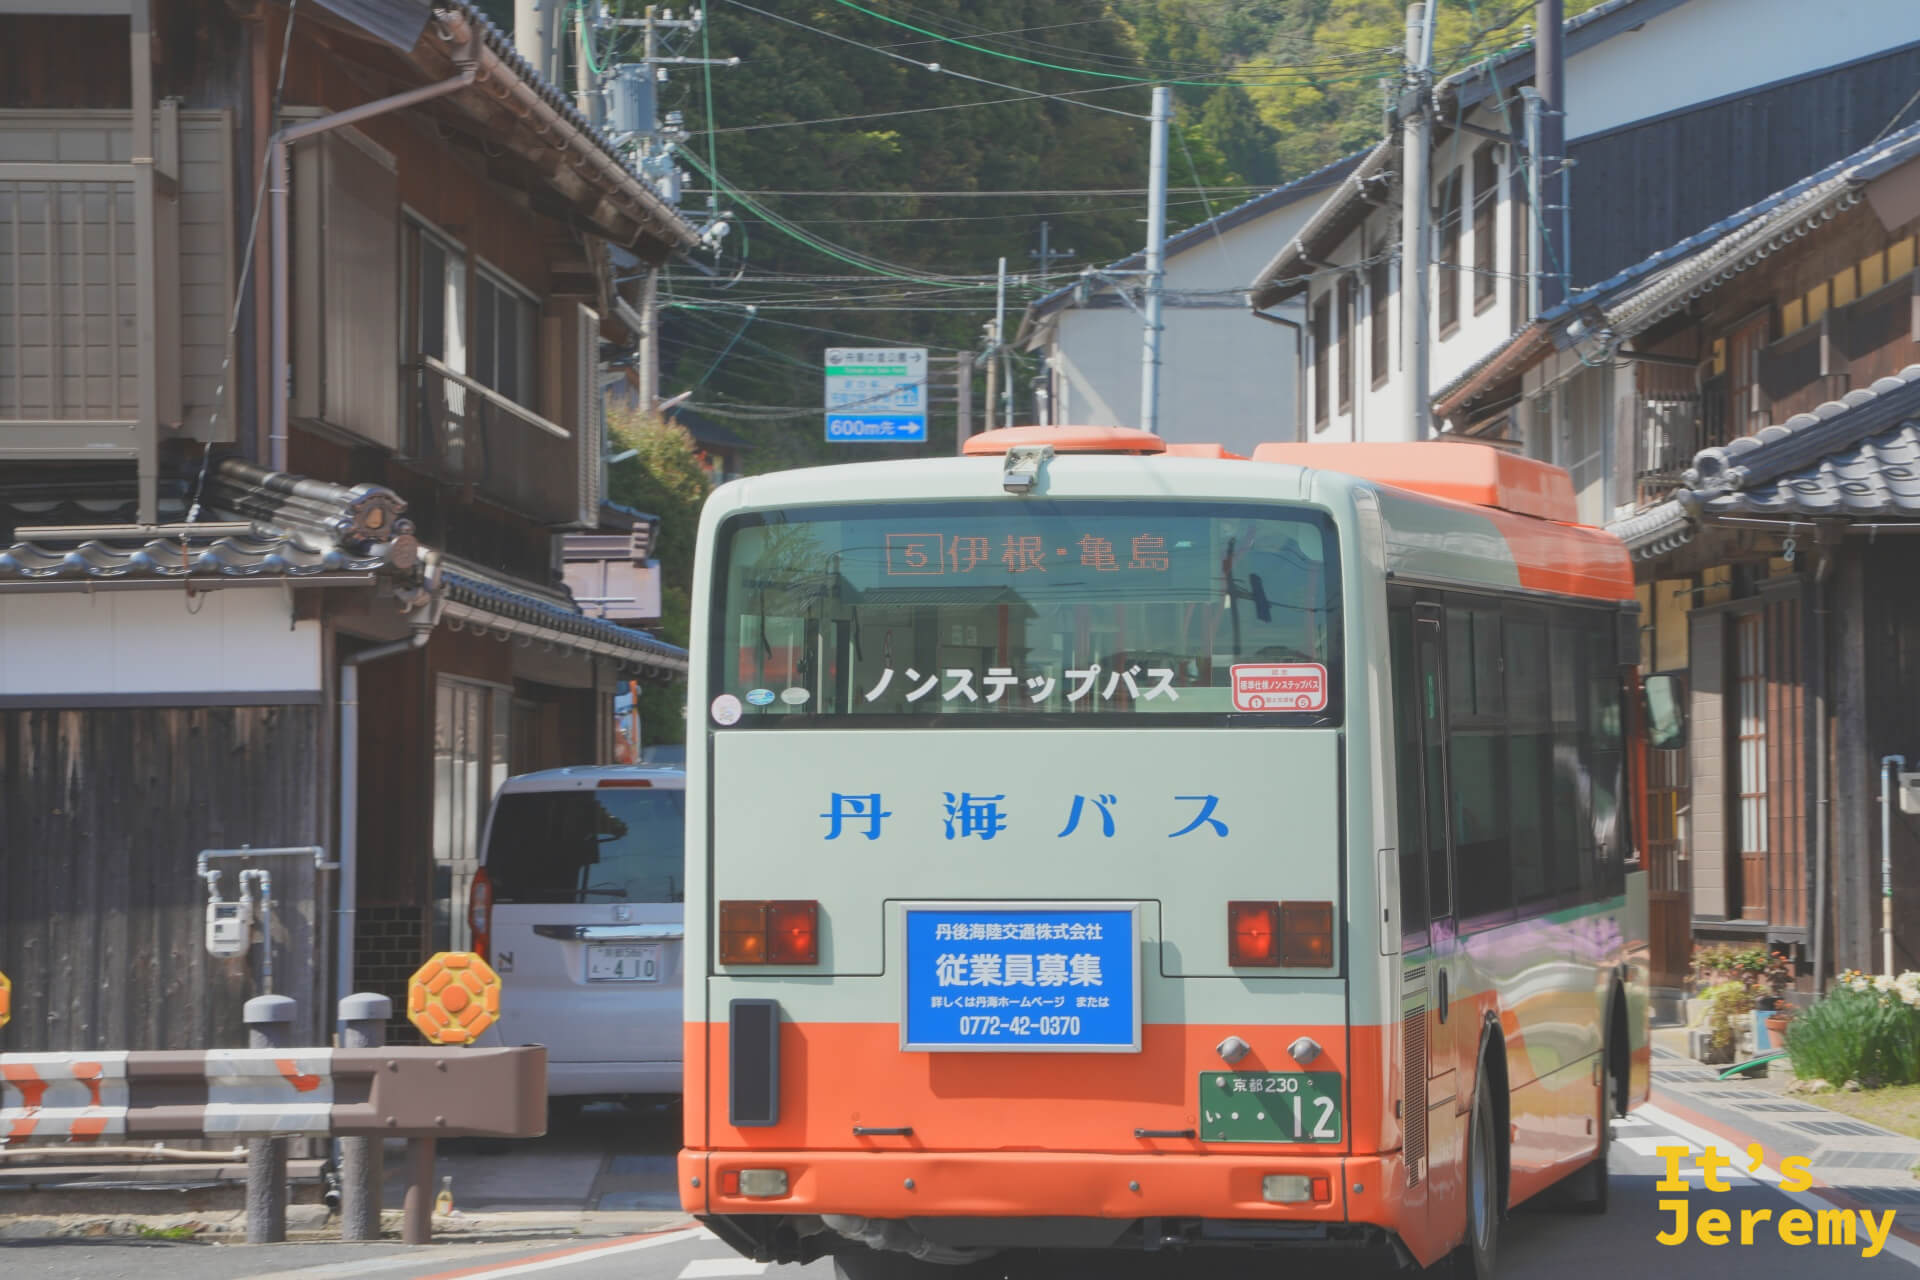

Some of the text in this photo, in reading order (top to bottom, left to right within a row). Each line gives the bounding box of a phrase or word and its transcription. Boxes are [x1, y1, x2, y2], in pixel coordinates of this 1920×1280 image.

[830, 419, 896, 436] 600m先
[947, 533, 1170, 573] 伊根・亀島
[864, 664, 1180, 703] ノンステップバス
[819, 792, 1230, 840] 丹海バス
[935, 923, 1104, 941] 丹後海陸交通株式会社
[935, 953, 1103, 987] 従業員募集
[930, 996, 1110, 1008] 詳しくは丹海ホームページ または
[959, 1016, 1081, 1036] 0772-42-0370
